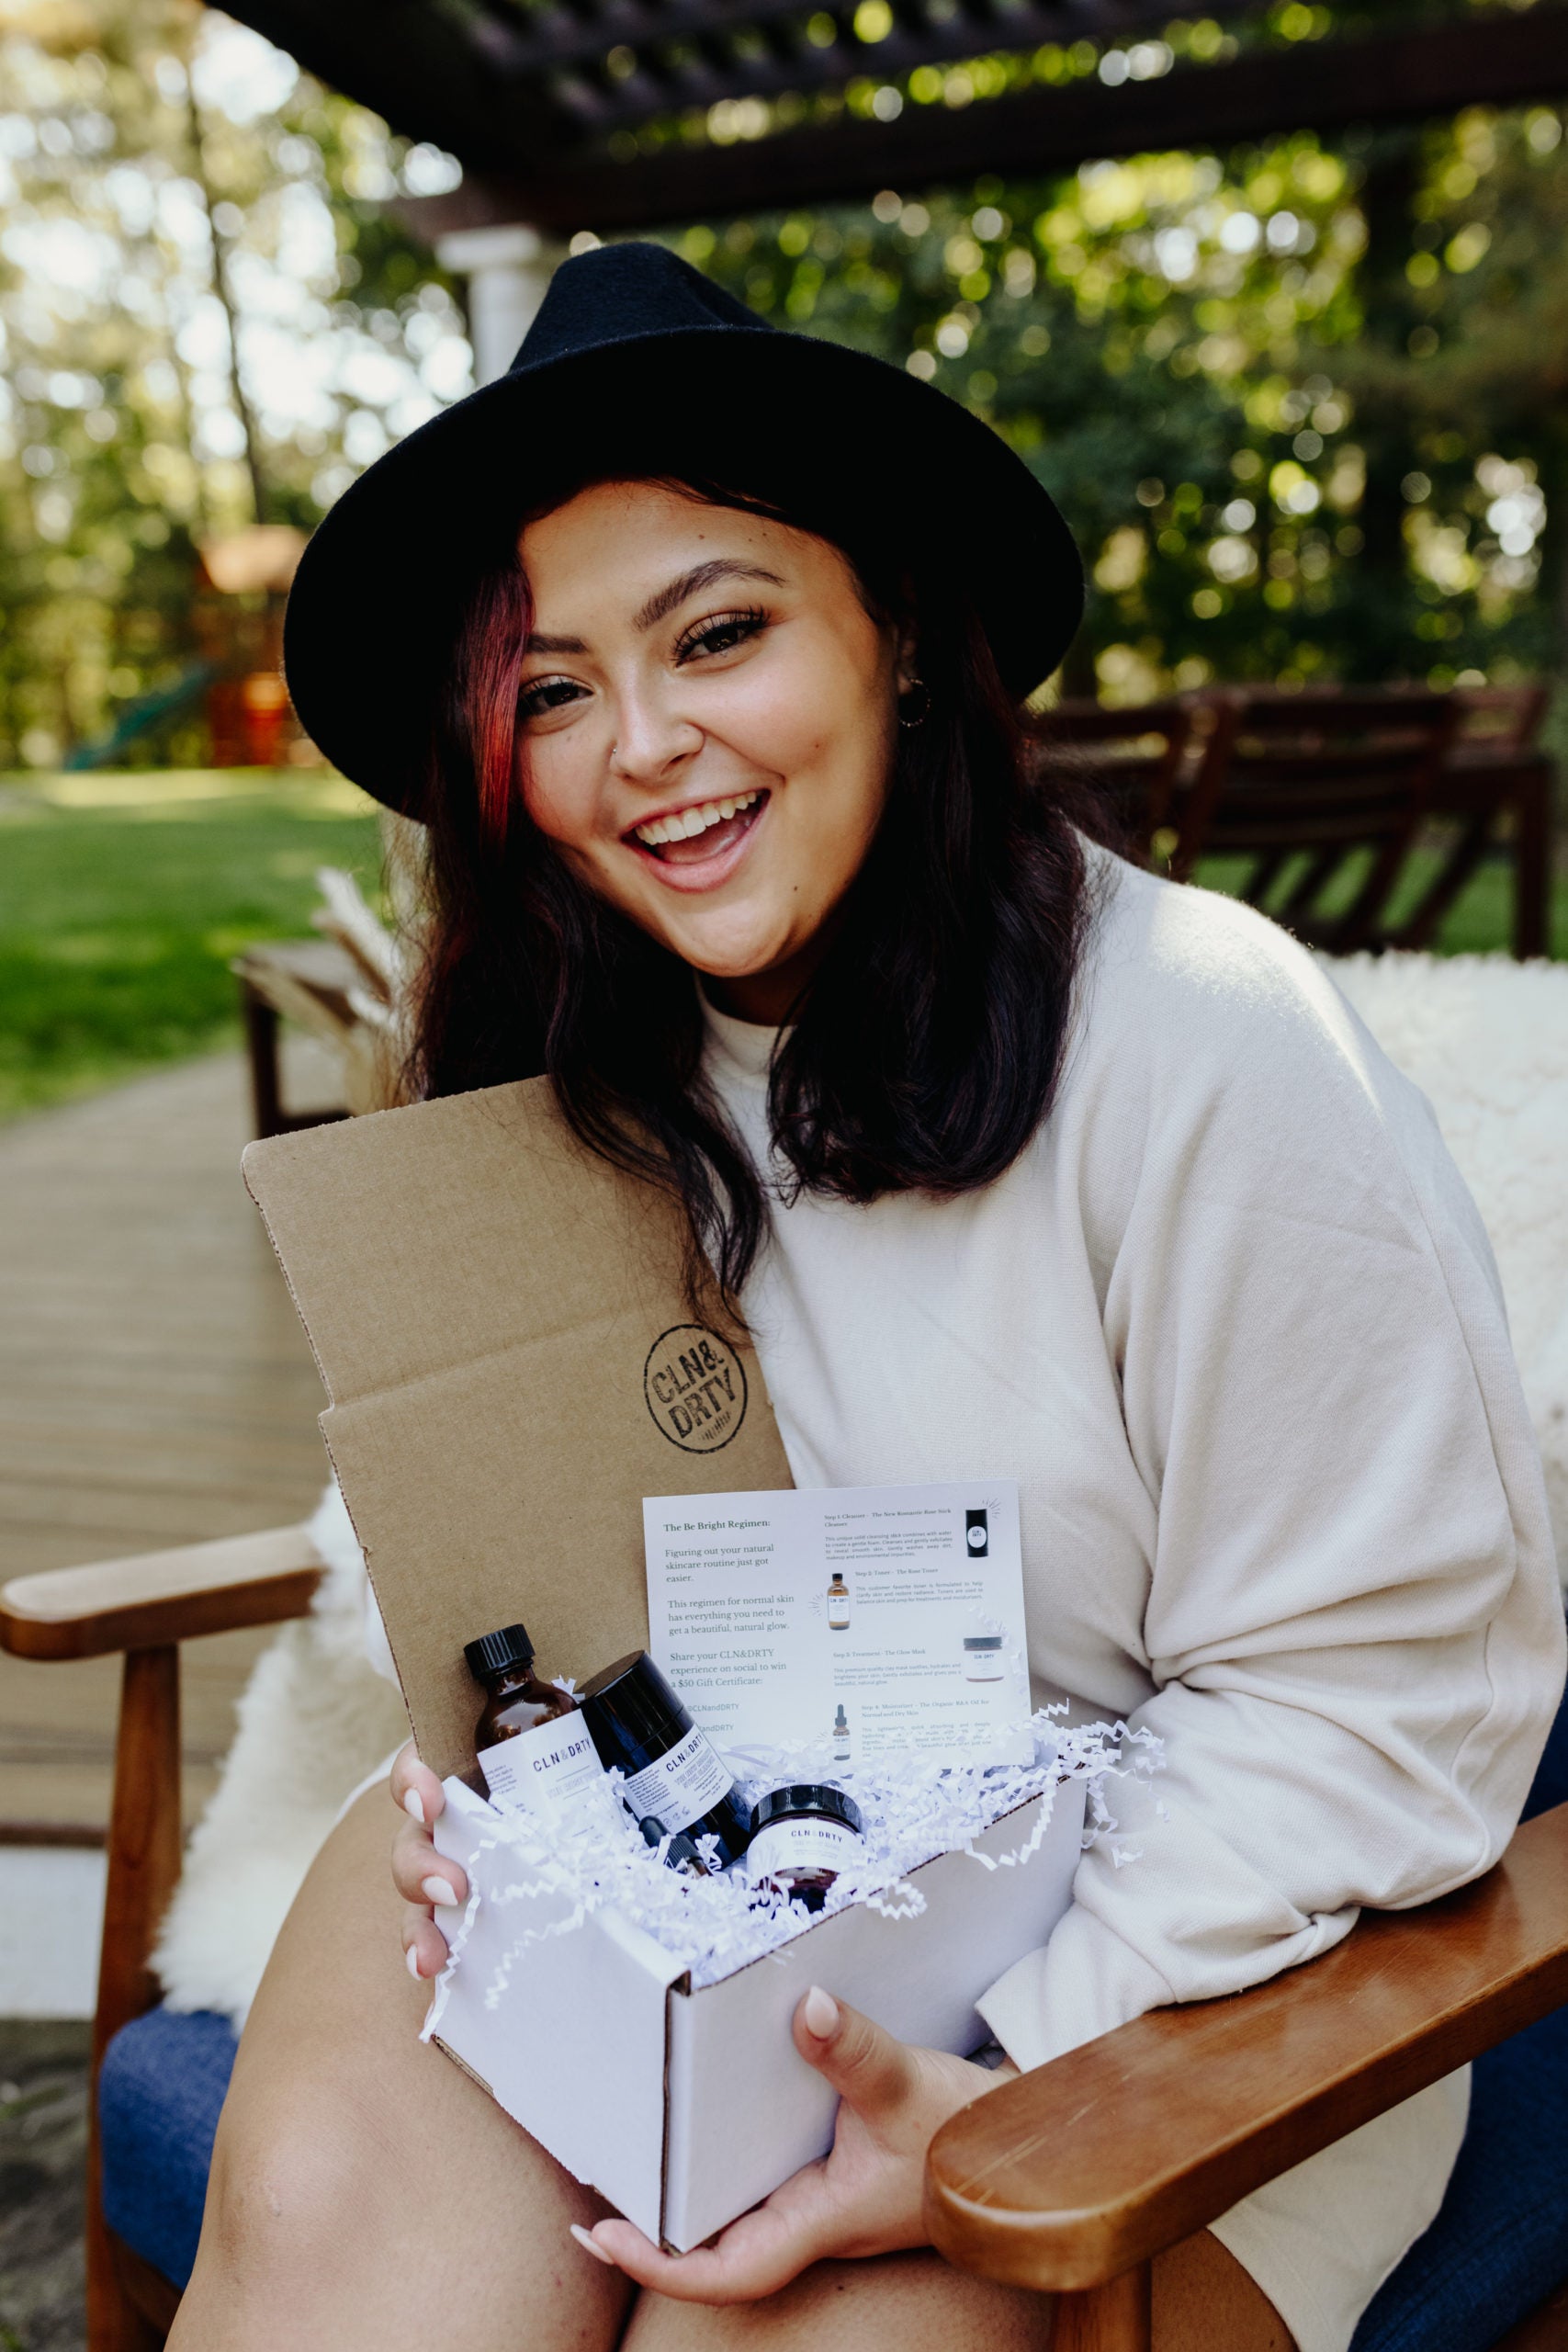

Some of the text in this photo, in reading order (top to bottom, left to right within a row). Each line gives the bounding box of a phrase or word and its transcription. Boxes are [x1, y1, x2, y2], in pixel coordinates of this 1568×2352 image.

[651, 1340, 724, 1403] CLN&
[668, 1367, 735, 1438] DRTY
[698, 1521, 726, 1531] Bright
[728, 1520, 771, 1529] Regimen:
[665, 1549, 702, 1558] Figuring
[721, 1548, 740, 1556] your
[744, 1544, 774, 1554] natural
[666, 1558, 769, 1570] skincare routine just got
[666, 1575, 694, 1583] easier.
[668, 1595, 795, 1609] This regimen for normal skin
[668, 1609, 784, 1622] has everything you need to
[669, 1628, 682, 1636] get
[691, 1624, 732, 1634] beautiful,
[734, 1623, 764, 1632] natural
[767, 1622, 790, 1632] glow.
[670, 1649, 774, 1662] Share your CLN&DRTY
[671, 1666, 717, 1676] experience
[733, 1663, 758, 1672] social
[760, 1663, 769, 1671] to
[771, 1662, 787, 1670] win
[678, 1679, 694, 1689] $50
[696, 1678, 714, 1687] Gift
[716, 1677, 763, 1687] Certificate:
[533, 1737, 592, 1772] CLN&DRTY
[791, 1829, 842, 1843] CLNDRTY
